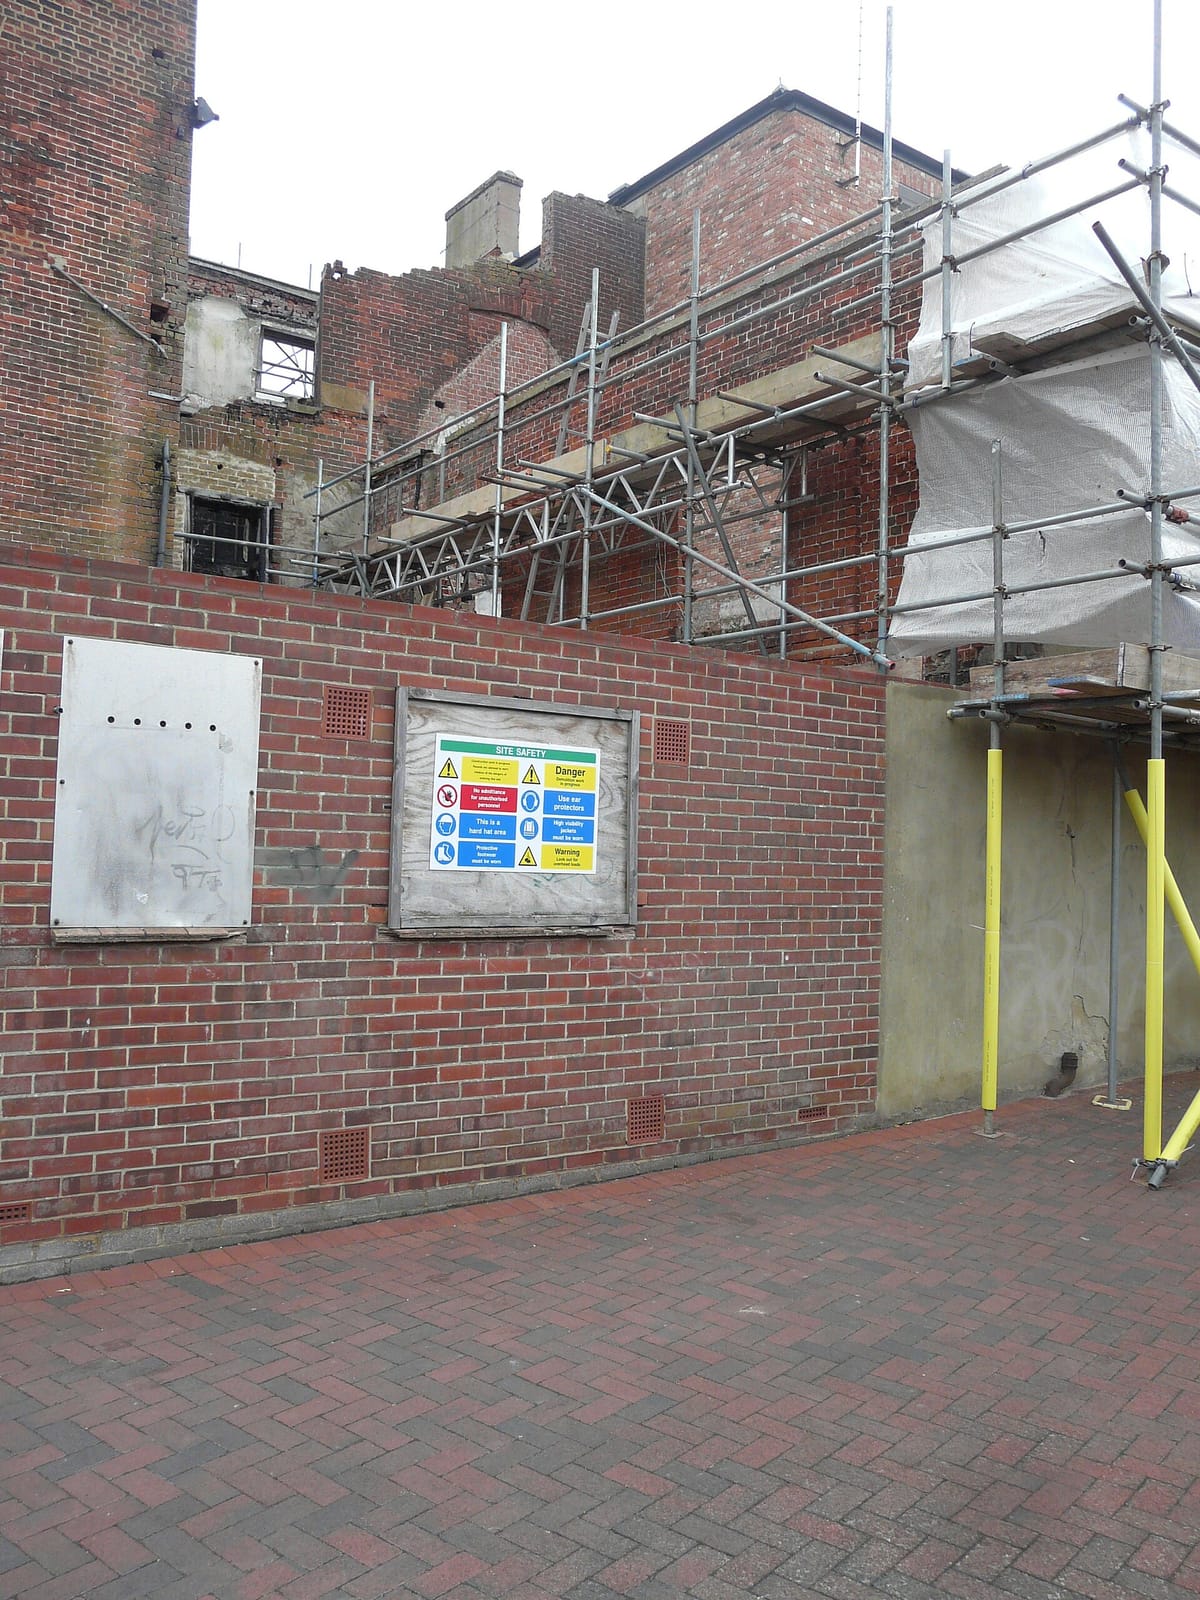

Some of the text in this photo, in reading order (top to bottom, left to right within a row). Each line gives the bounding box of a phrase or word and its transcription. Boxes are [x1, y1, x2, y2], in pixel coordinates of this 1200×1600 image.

[496, 746, 546, 758] SITE SAFETY
[556, 766, 586, 778] Danger
[554, 804, 584, 812] protectors
[564, 820, 584, 828] visibility
[554, 848, 580, 856] Warning
